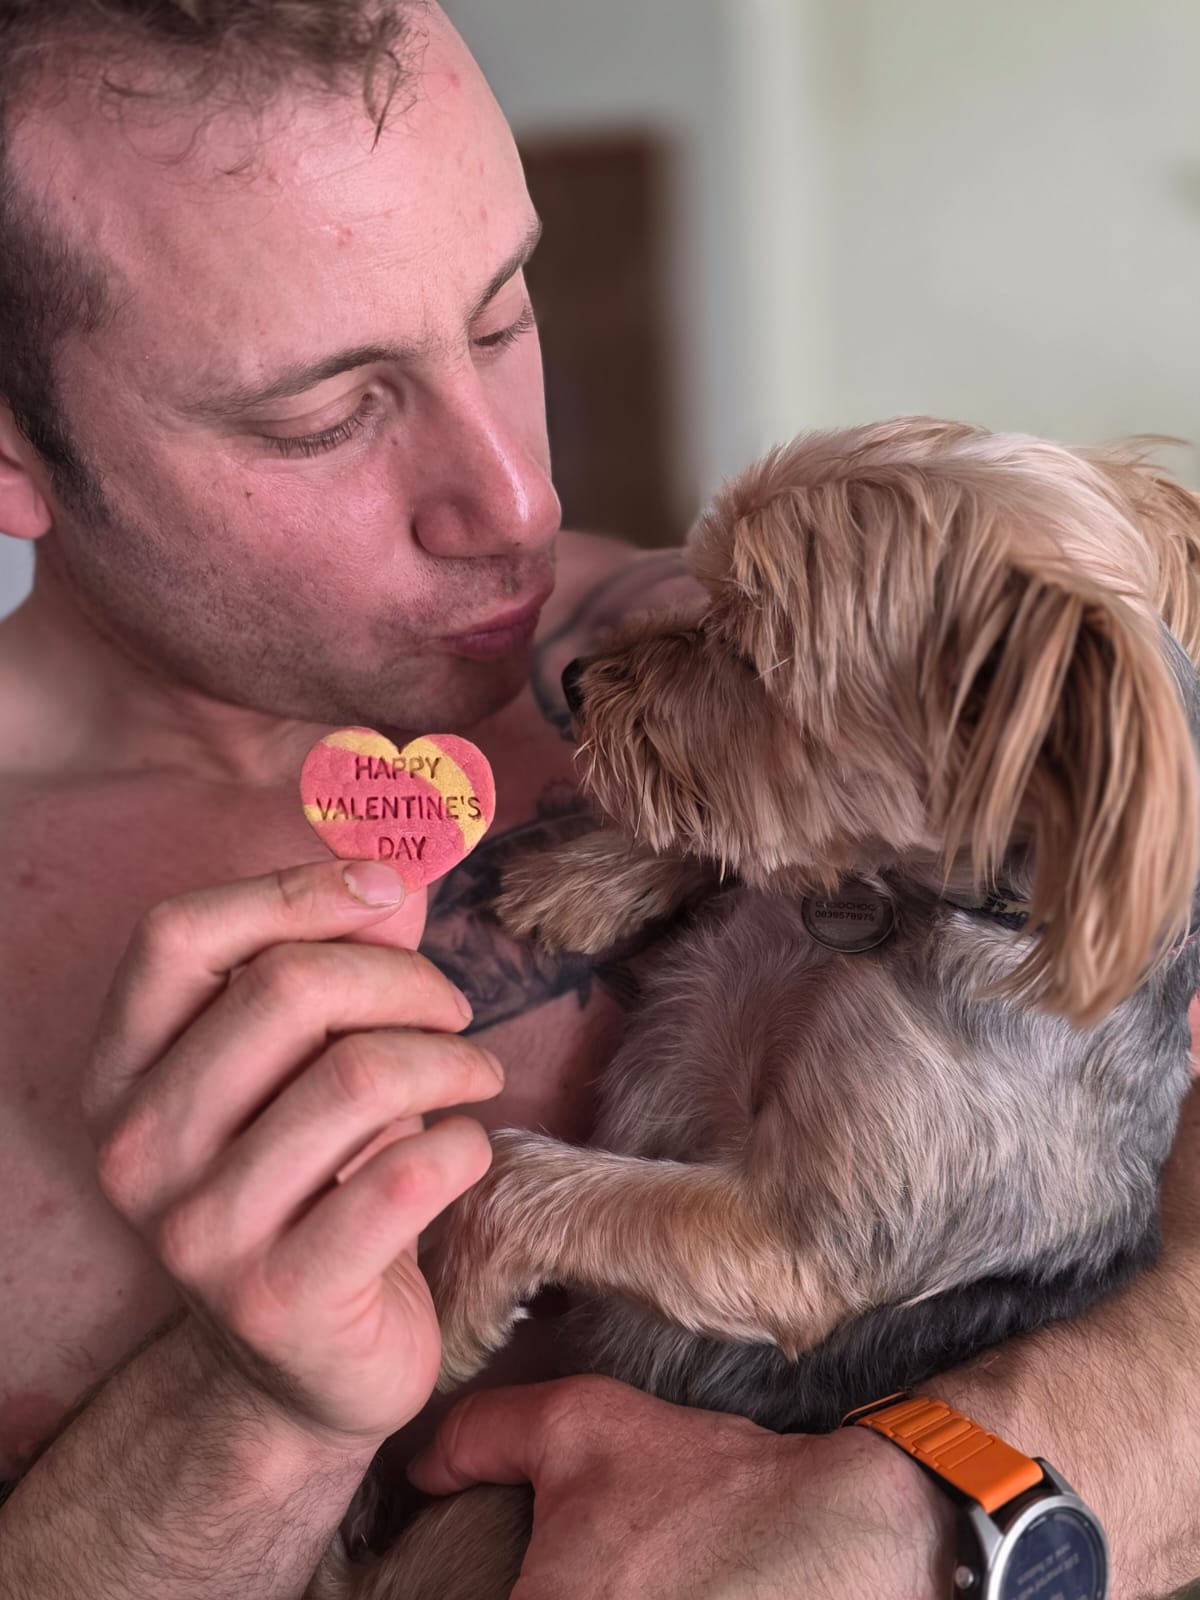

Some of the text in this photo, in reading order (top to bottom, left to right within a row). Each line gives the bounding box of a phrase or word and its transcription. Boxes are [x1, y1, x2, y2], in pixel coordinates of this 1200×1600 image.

[355, 755, 441, 780] HAPPY
[316, 795, 482, 820] VALENTINE'S
[378, 836, 426, 860] DAY
